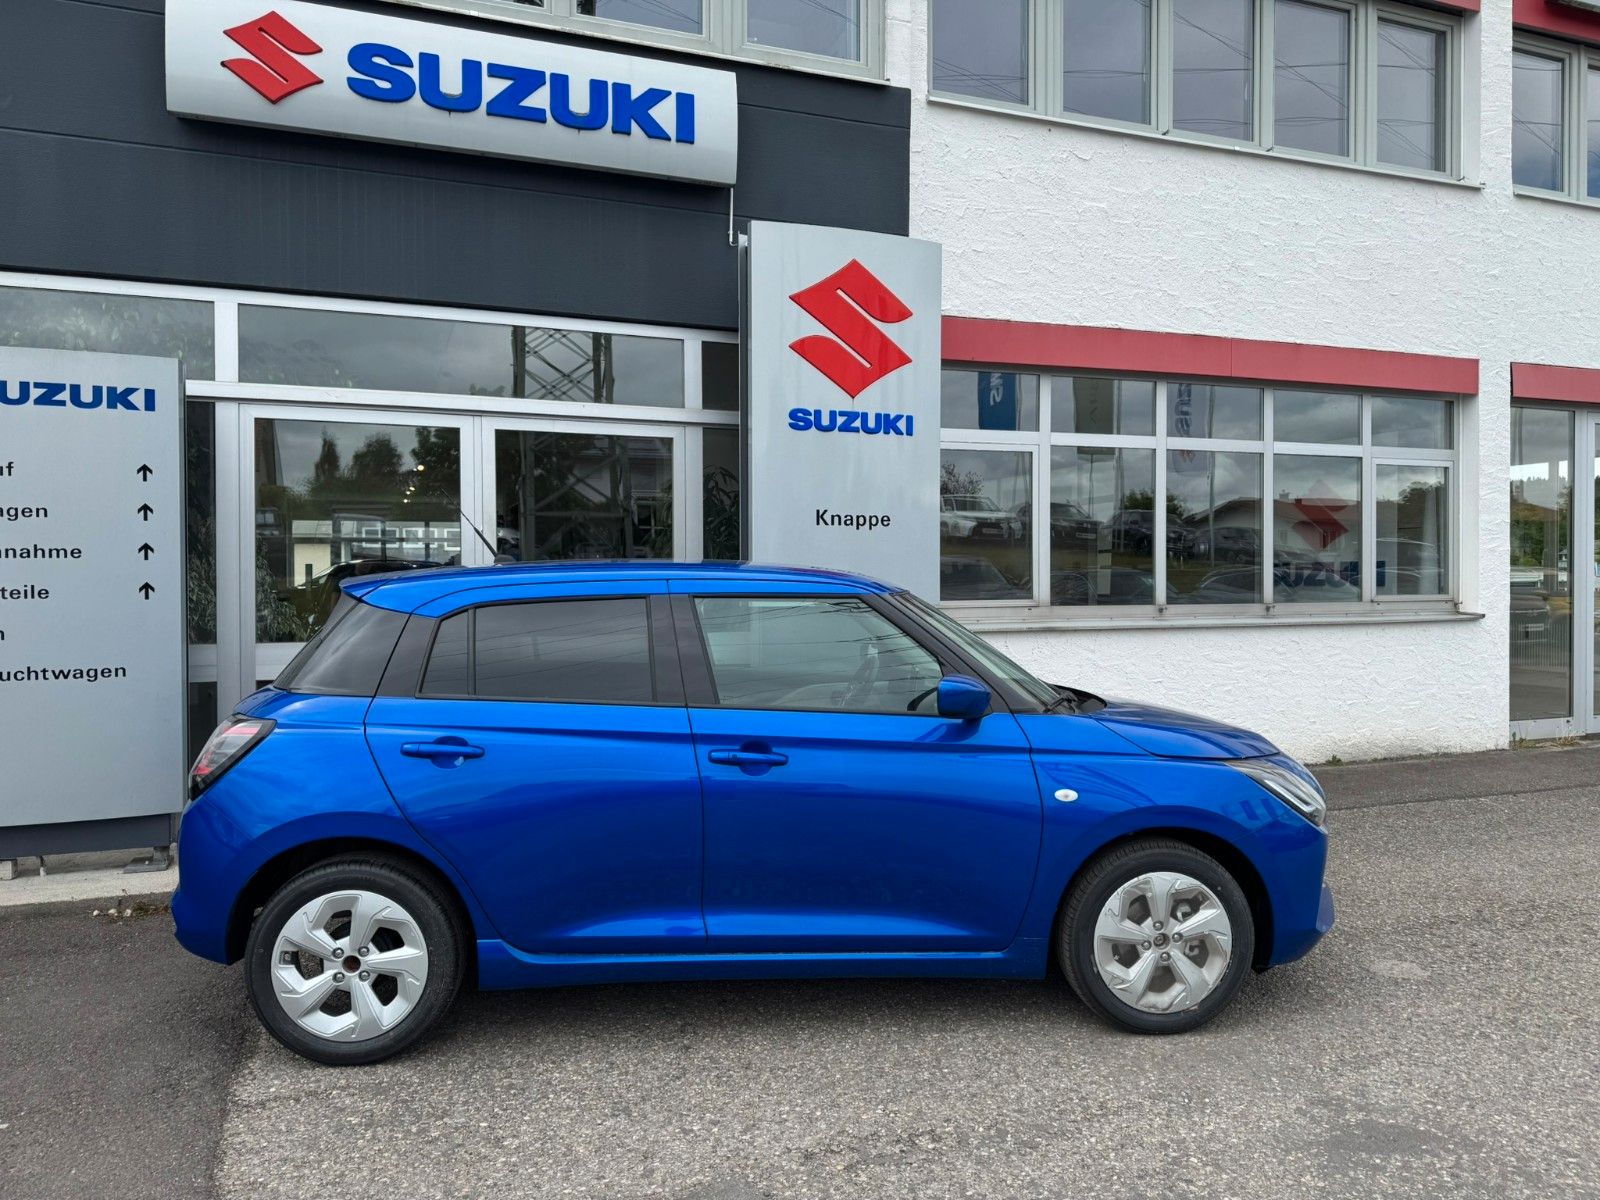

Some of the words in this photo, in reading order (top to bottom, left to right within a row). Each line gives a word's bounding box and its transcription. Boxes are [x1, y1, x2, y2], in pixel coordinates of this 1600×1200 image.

[346, 42, 695, 144] SUZUKI
[0, 380, 156, 412] UZUKI
[788, 408, 914, 436] SUZUKI
[815, 509, 891, 530] Knappe
[0, 544, 82, 559] nahme
[0, 666, 127, 682] uchtwagen
